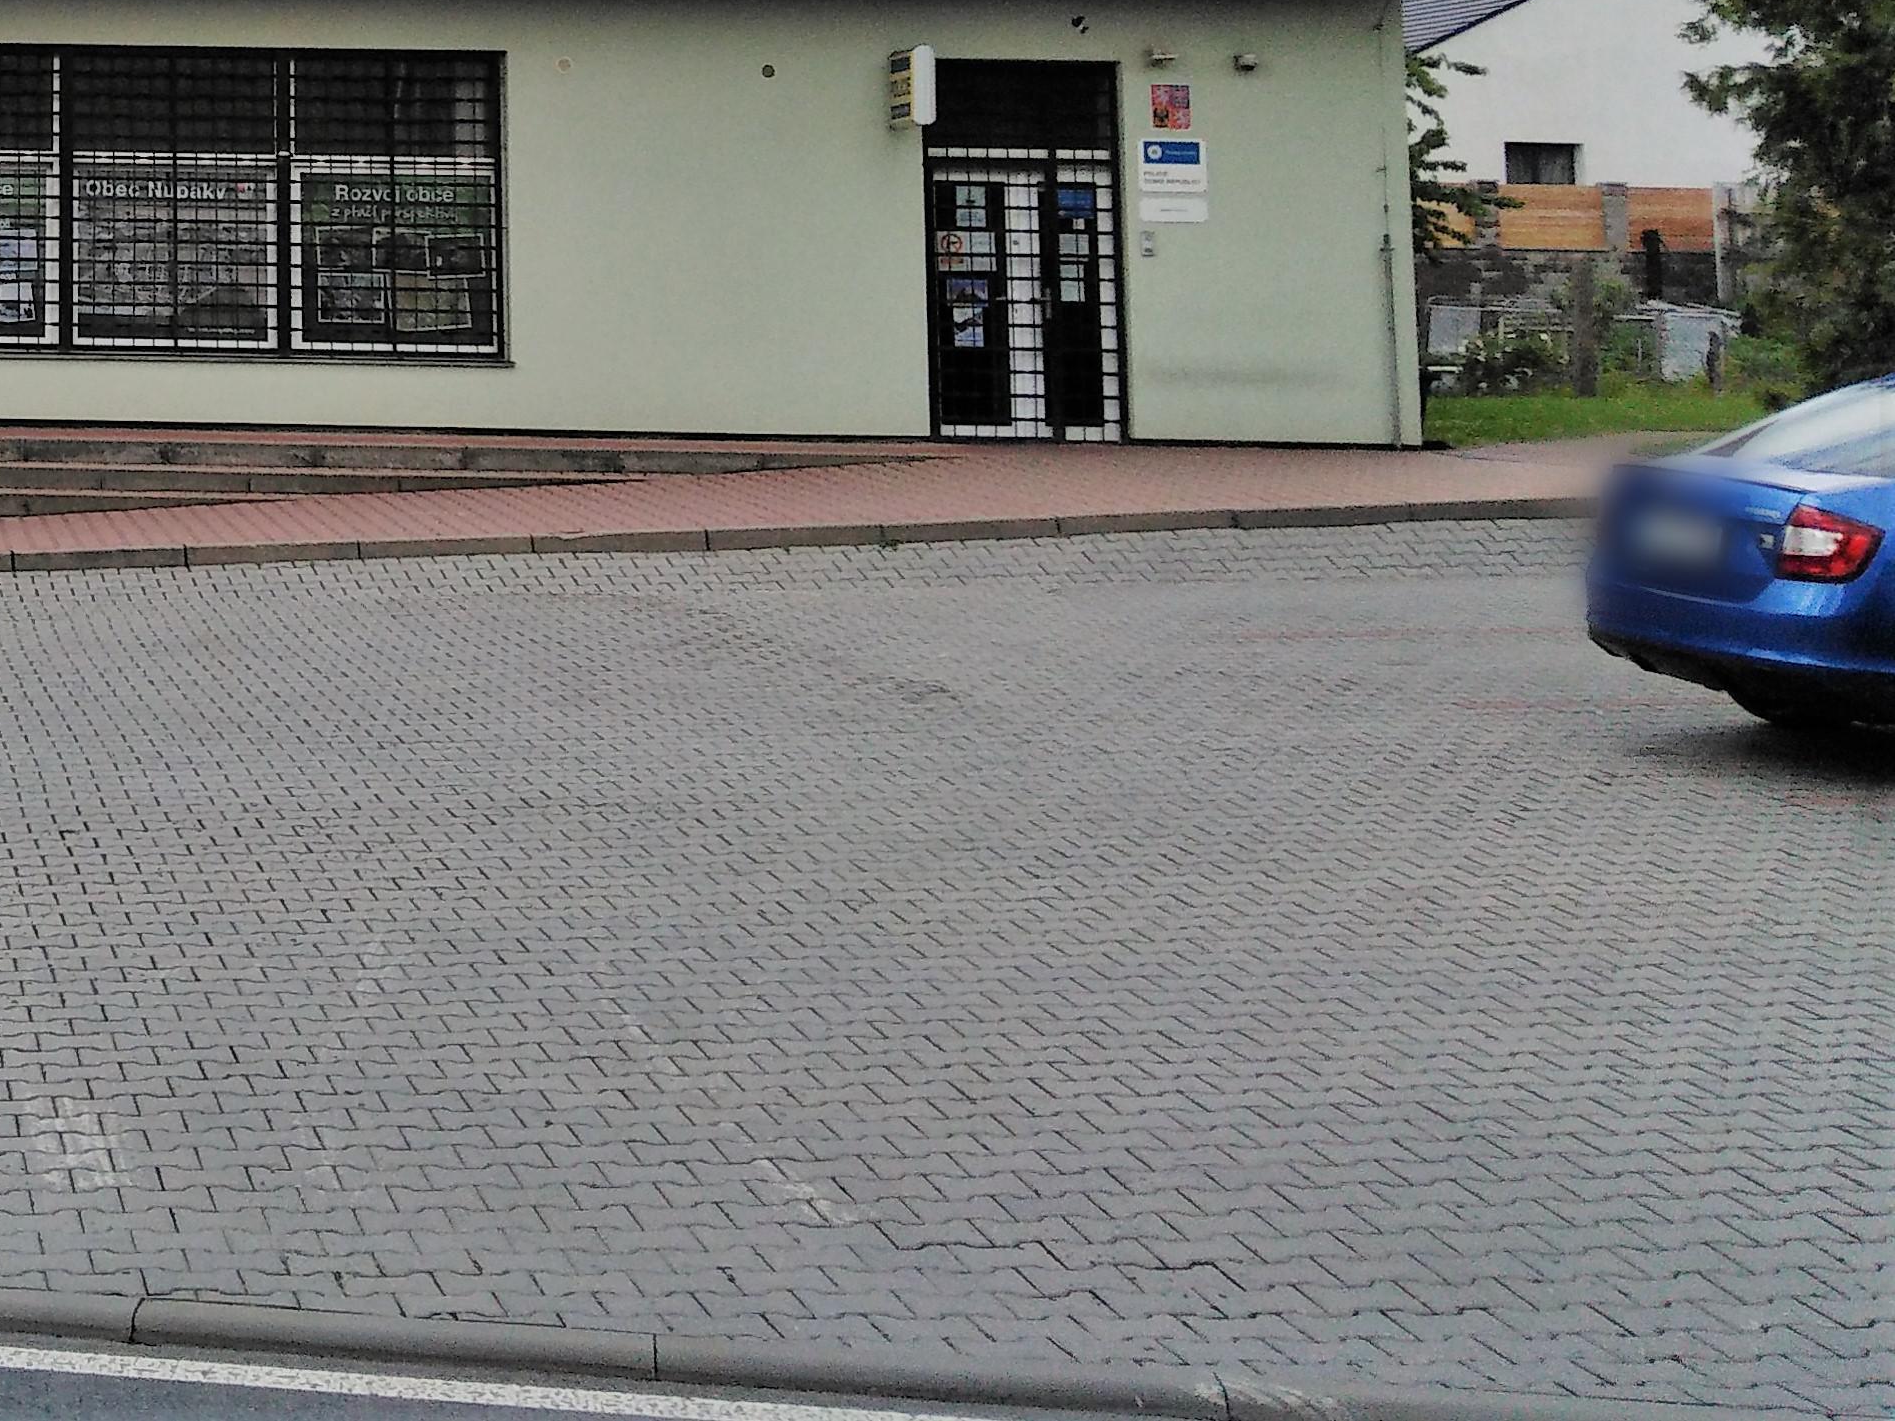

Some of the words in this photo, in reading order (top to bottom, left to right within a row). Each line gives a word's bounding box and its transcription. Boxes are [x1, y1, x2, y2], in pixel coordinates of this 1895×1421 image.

[85, 179, 140, 198] Obec
[334, 183, 401, 204] Rozvoj
[406, 184, 455, 203] obce
